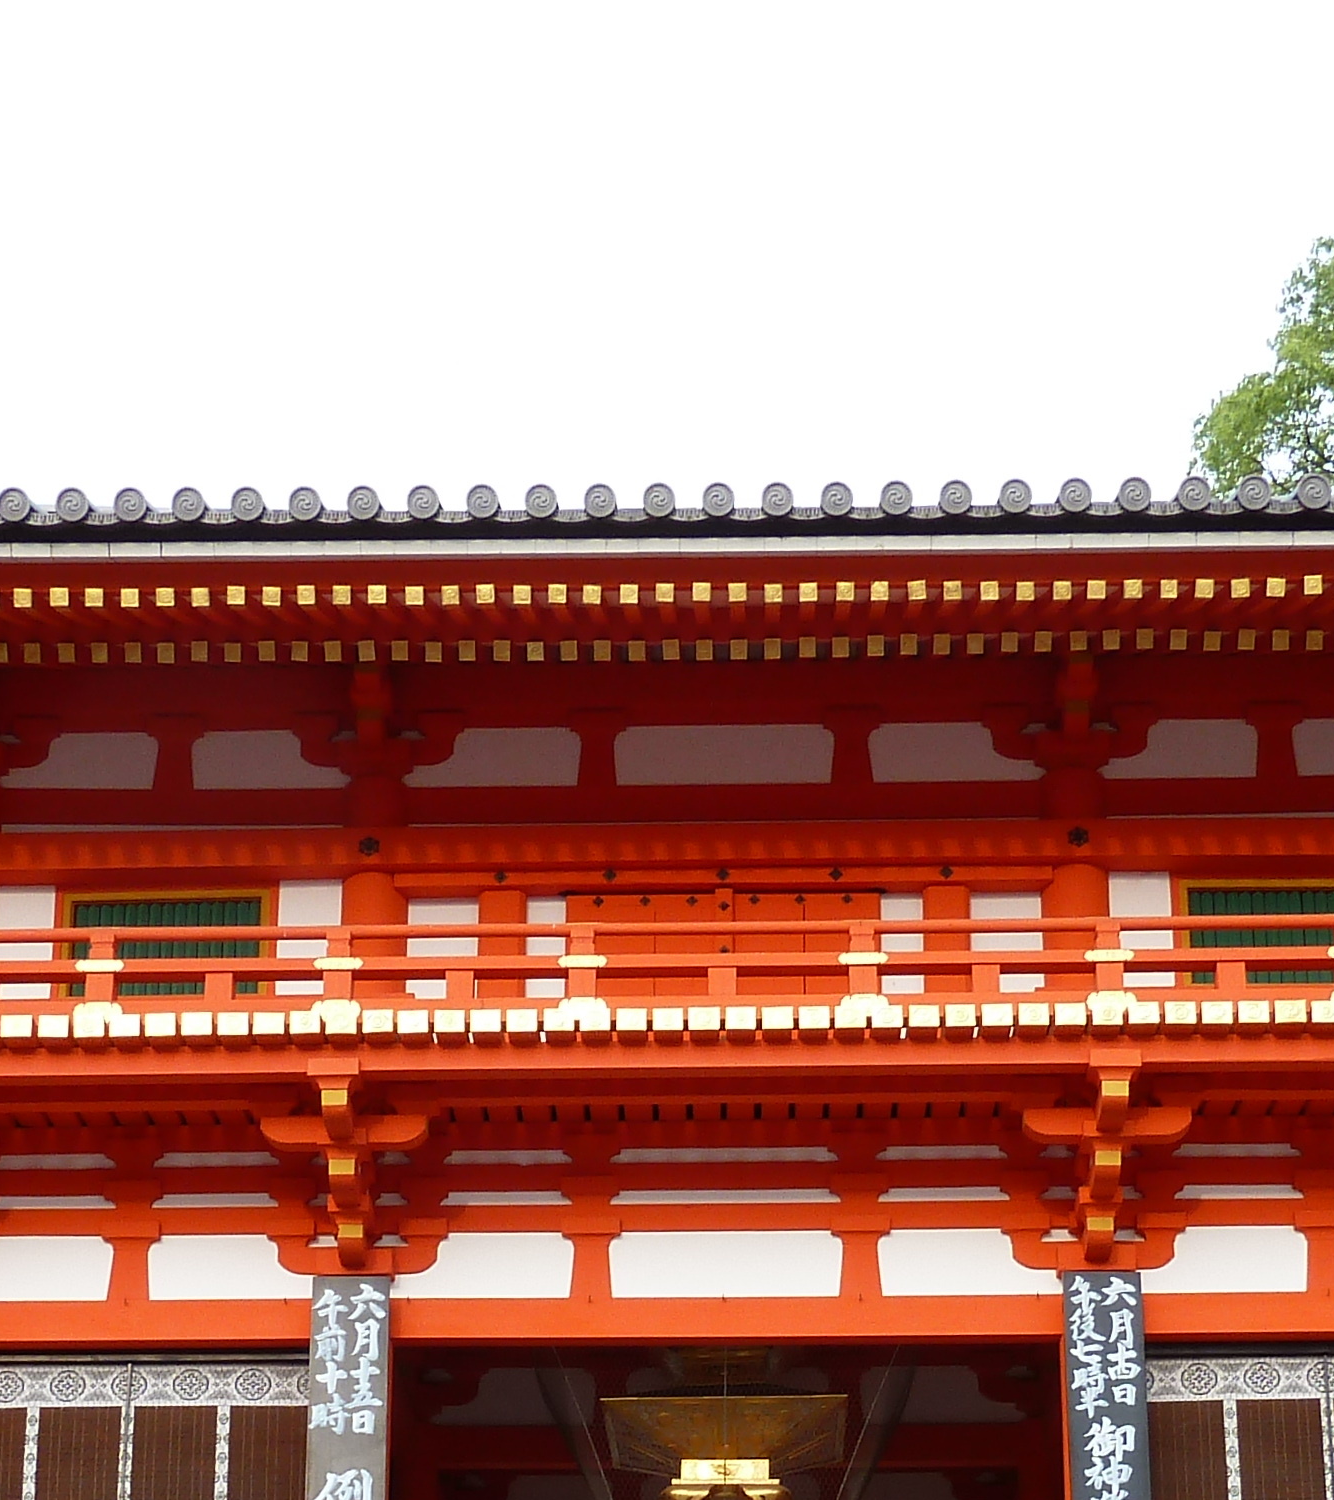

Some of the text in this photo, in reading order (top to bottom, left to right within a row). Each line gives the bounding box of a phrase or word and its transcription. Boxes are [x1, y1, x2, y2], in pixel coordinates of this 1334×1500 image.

[309, 1290, 348, 1435] 午前十時
[347, 1283, 386, 1434] 六月十五日
